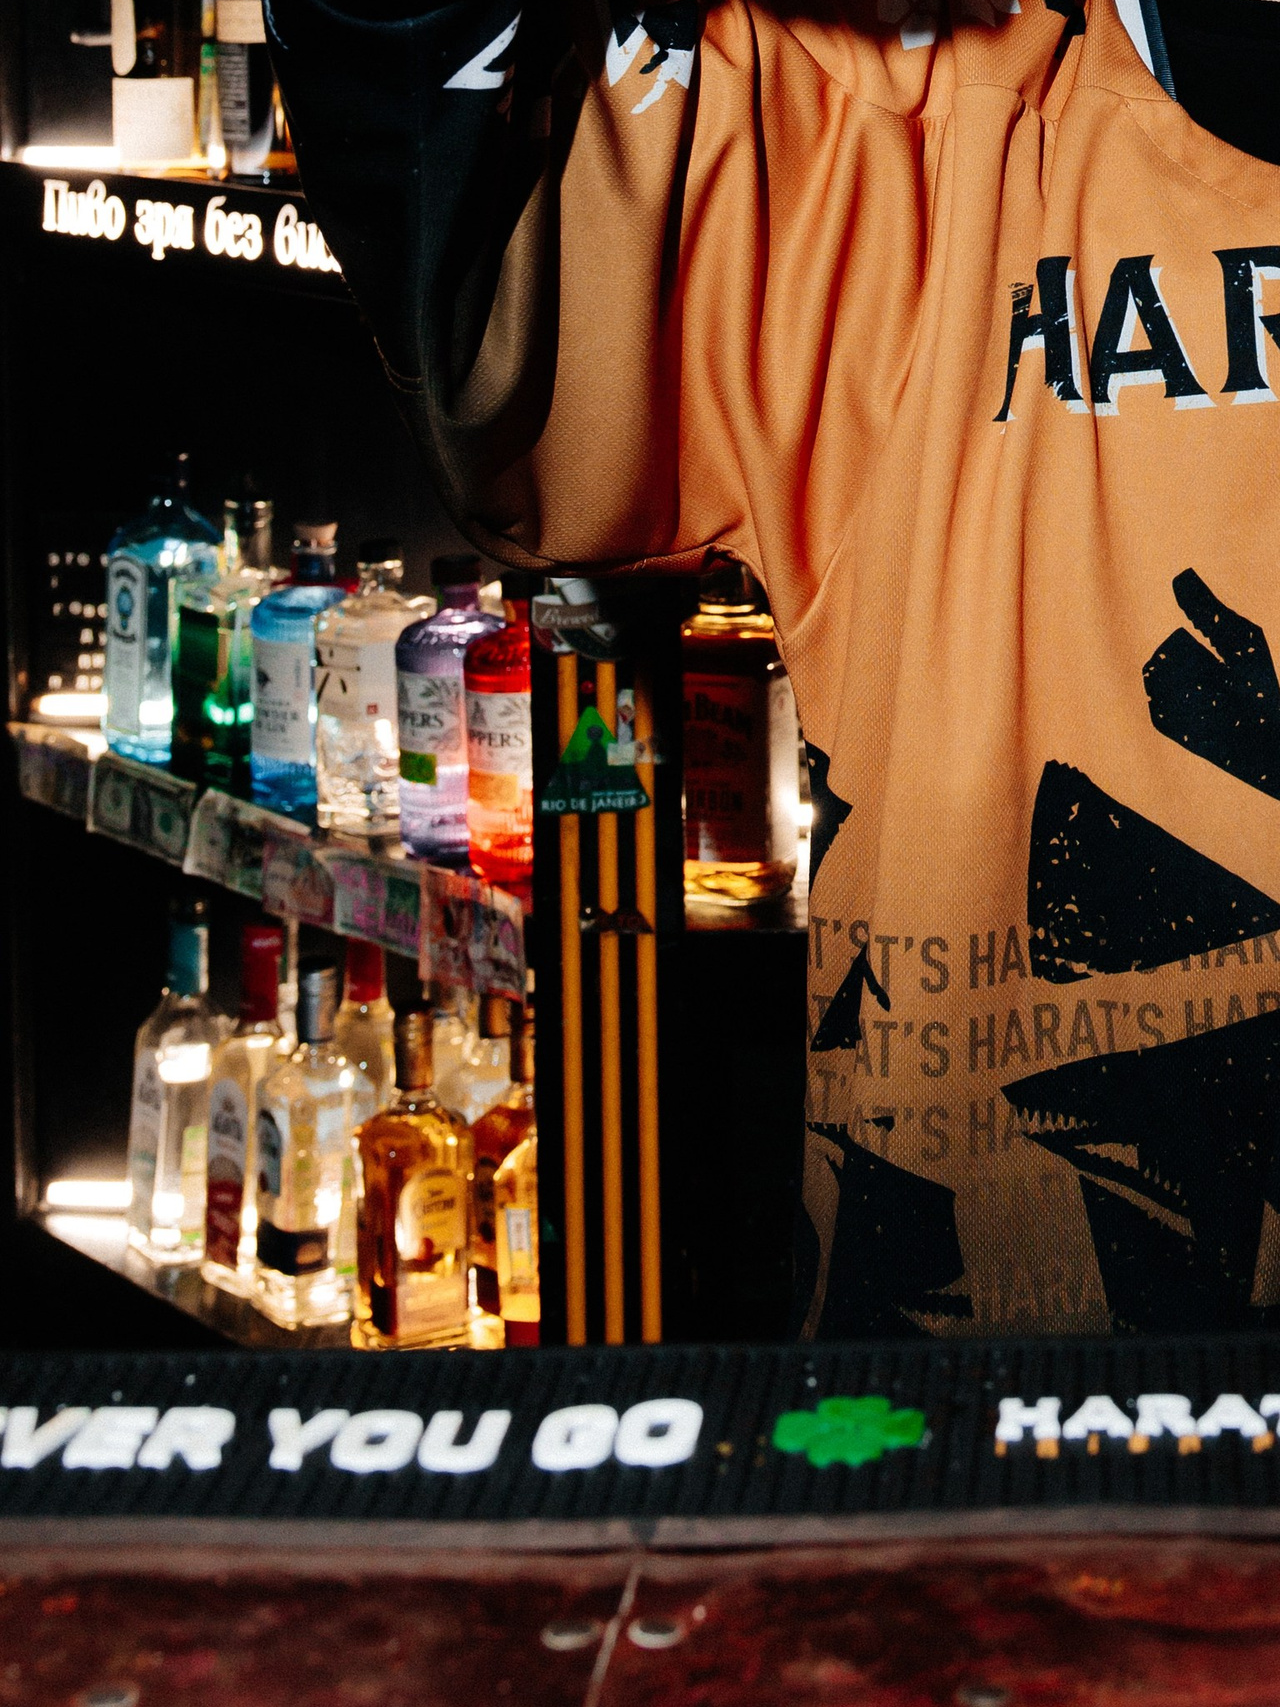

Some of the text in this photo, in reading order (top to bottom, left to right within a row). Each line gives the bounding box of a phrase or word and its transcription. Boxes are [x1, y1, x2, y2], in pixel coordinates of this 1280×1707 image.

[42, 178, 127, 241] Пиво
[134, 198, 195, 261] зря
[204, 195, 264, 261] без
[541, 798, 566, 812] RIO
[570, 797, 588, 811] DE
[0, 1396, 706, 1474] VER YOU GO
